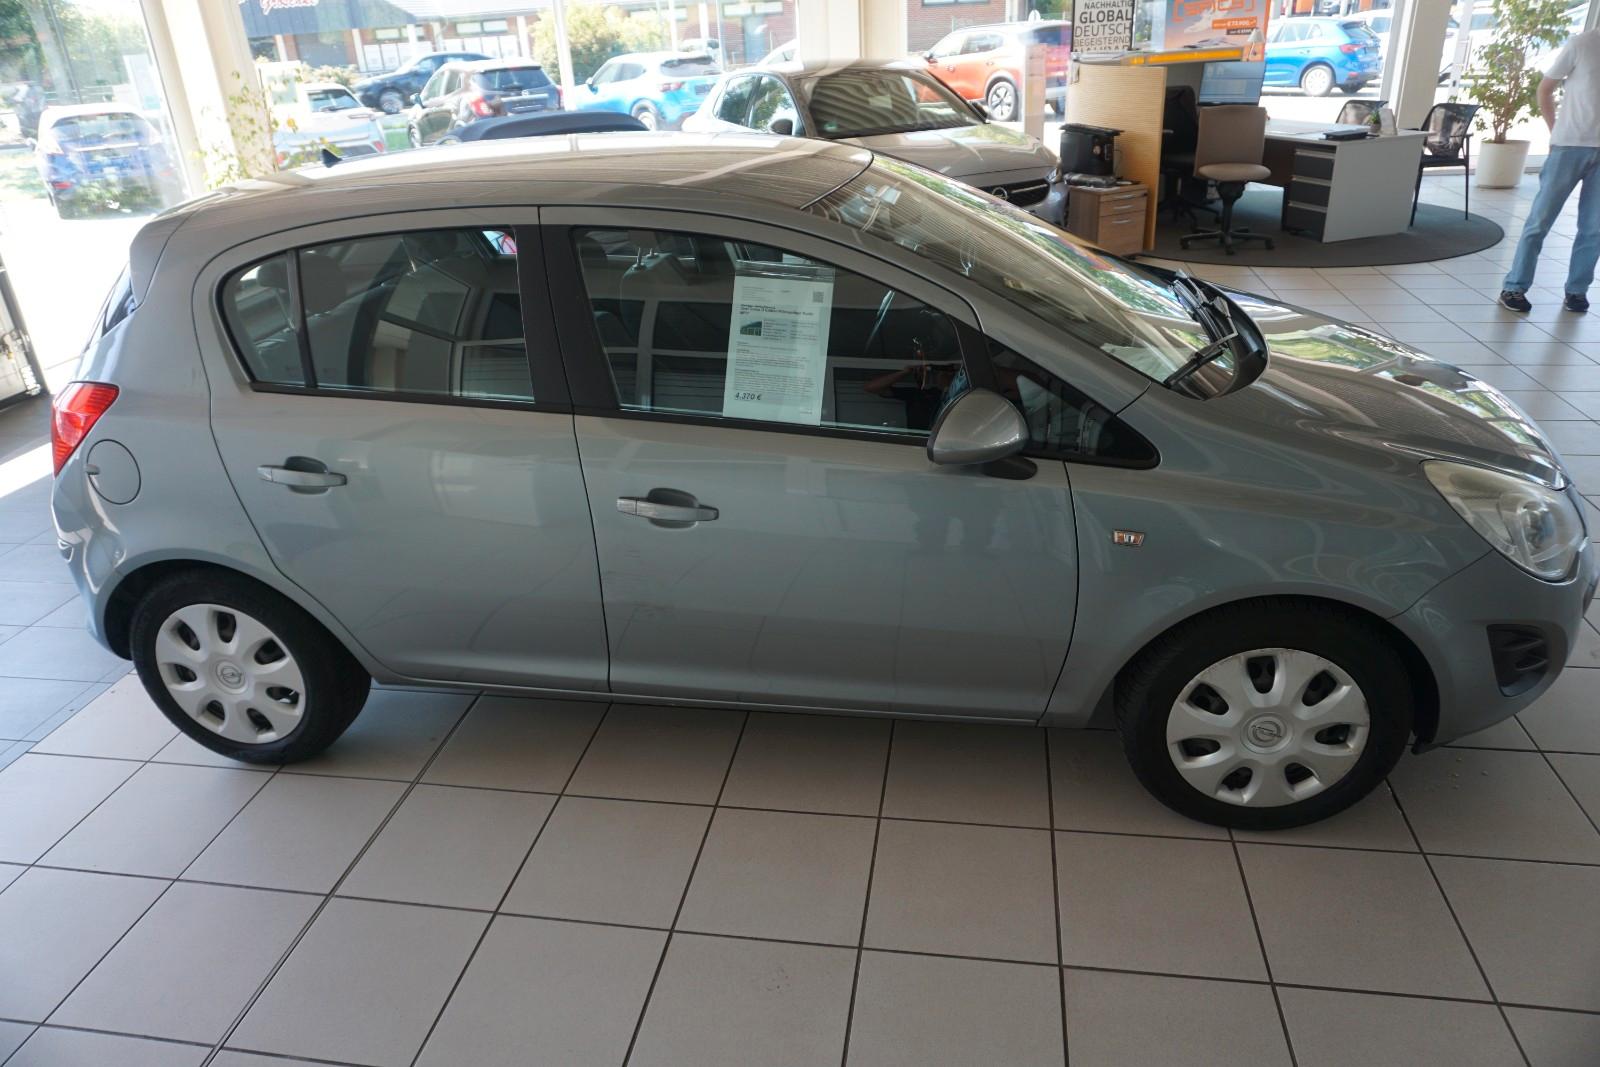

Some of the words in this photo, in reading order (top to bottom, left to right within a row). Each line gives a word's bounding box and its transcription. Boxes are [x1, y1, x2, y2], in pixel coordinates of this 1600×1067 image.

[1080, 9, 1132, 24] GLOBAL
[1075, 23, 1131, 37] DEUTSCH
[735, 392, 755, 401] 4.370
